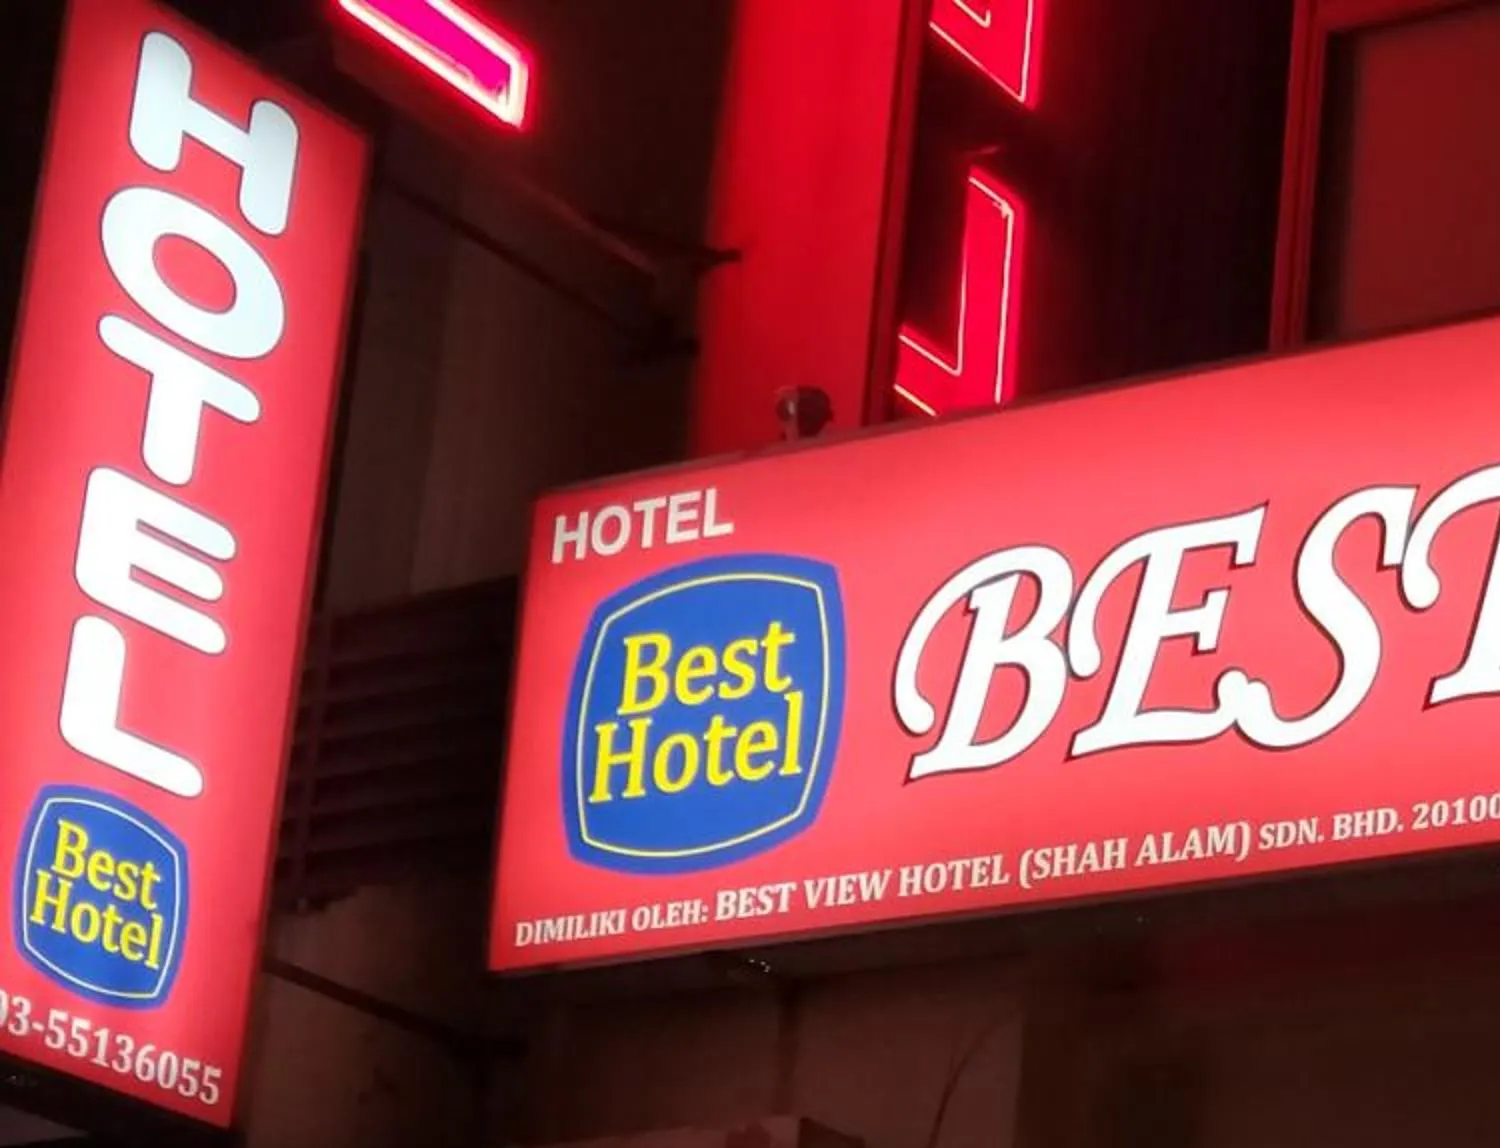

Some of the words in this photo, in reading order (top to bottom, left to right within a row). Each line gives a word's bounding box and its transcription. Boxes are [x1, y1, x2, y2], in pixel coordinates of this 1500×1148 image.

[57, 30, 300, 799] HOTEL
[552, 487, 735, 564] HOTEL
[616, 620, 796, 717] Best
[588, 691, 804, 804] Hotel
[51, 817, 162, 911] Best
[514, 908, 627, 948] DIMILIKI
[631, 898, 710, 932] OLEH:
[714, 880, 799, 923] BEST
[802, 868, 894, 911] VIEW
[897, 853, 1011, 898] HOTEL
[1018, 837, 1129, 890] (SHAH
[1134, 820, 1253, 867] ALAM)
[1258, 815, 1326, 851] SDN.
[1331, 806, 1405, 842] BHD.
[29, 868, 164, 970] Hotel
